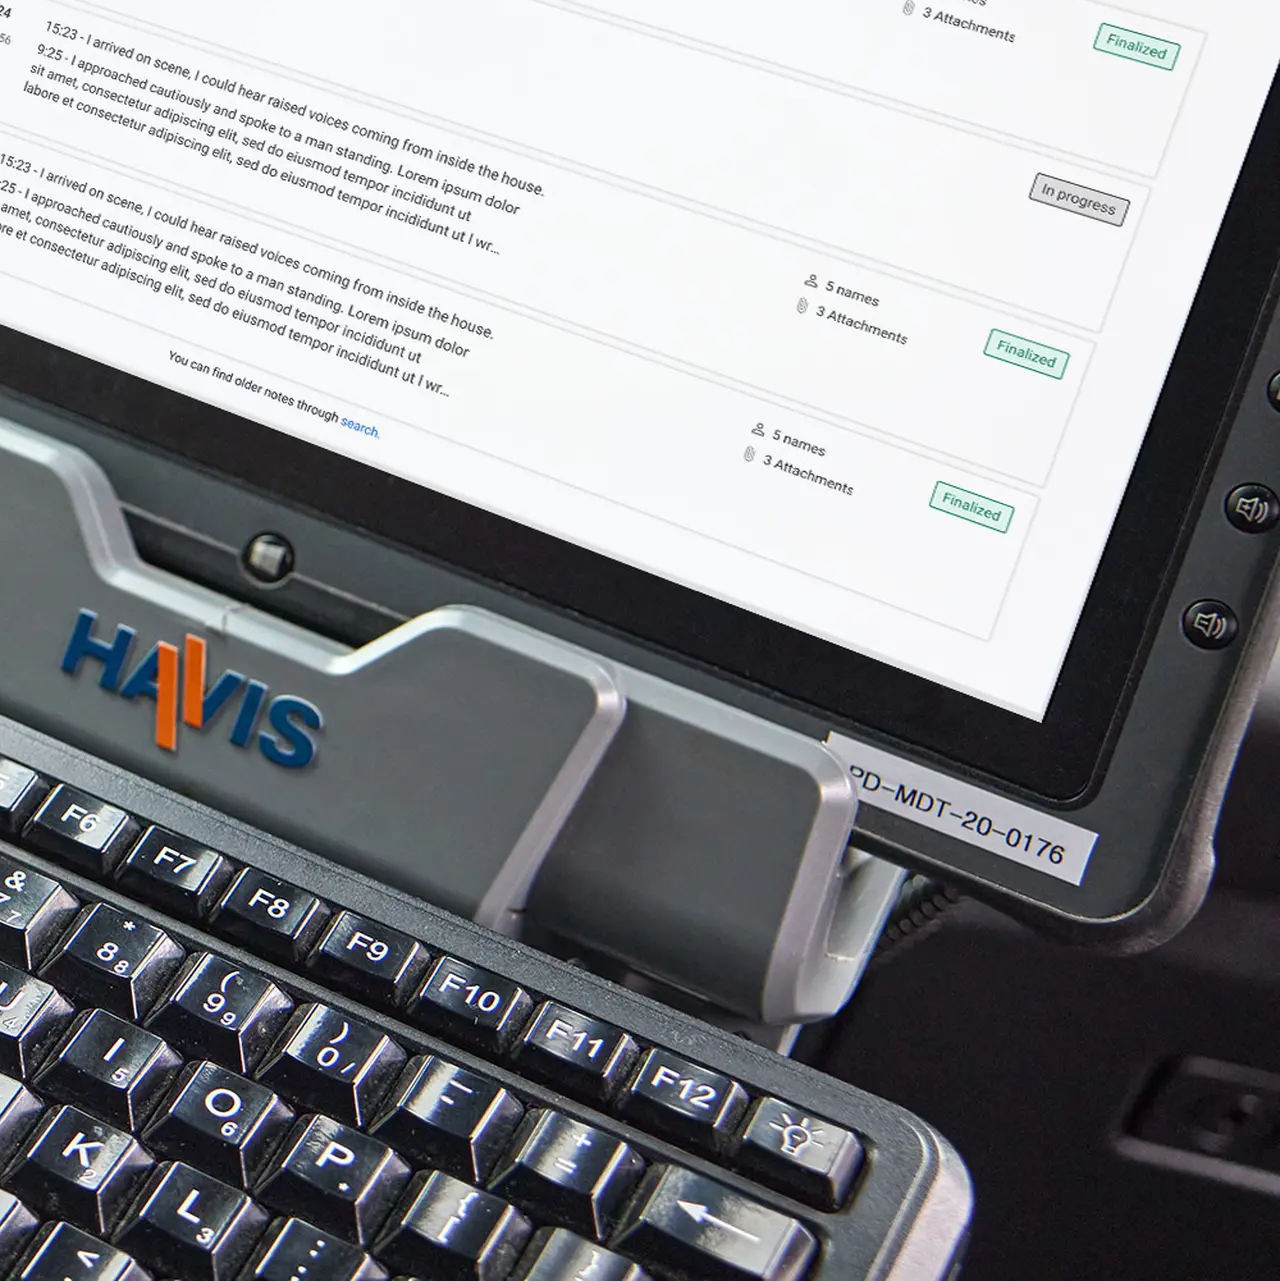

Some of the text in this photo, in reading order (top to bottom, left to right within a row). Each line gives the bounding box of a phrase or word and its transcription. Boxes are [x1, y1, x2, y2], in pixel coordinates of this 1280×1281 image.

[922, 6, 1016, 43] 3 Attachments
[1106, 33, 1168, 60] Finalized
[1041, 183, 1116, 216] In progress
[996, 339, 1057, 369] Finalized
[169, 350, 381, 438] You can find older notes through search.
[942, 492, 1002, 522] Finalized
[61, 607, 323, 768] HAVIS
[61, 803, 101, 832] F6
[153, 846, 197, 874] F7
[248, 888, 290, 919] F8
[346, 930, 390, 962] F9
[439, 973, 501, 1013] F10
[546, 1019, 605, 1059] F11
[651, 1065, 717, 1110] F12
